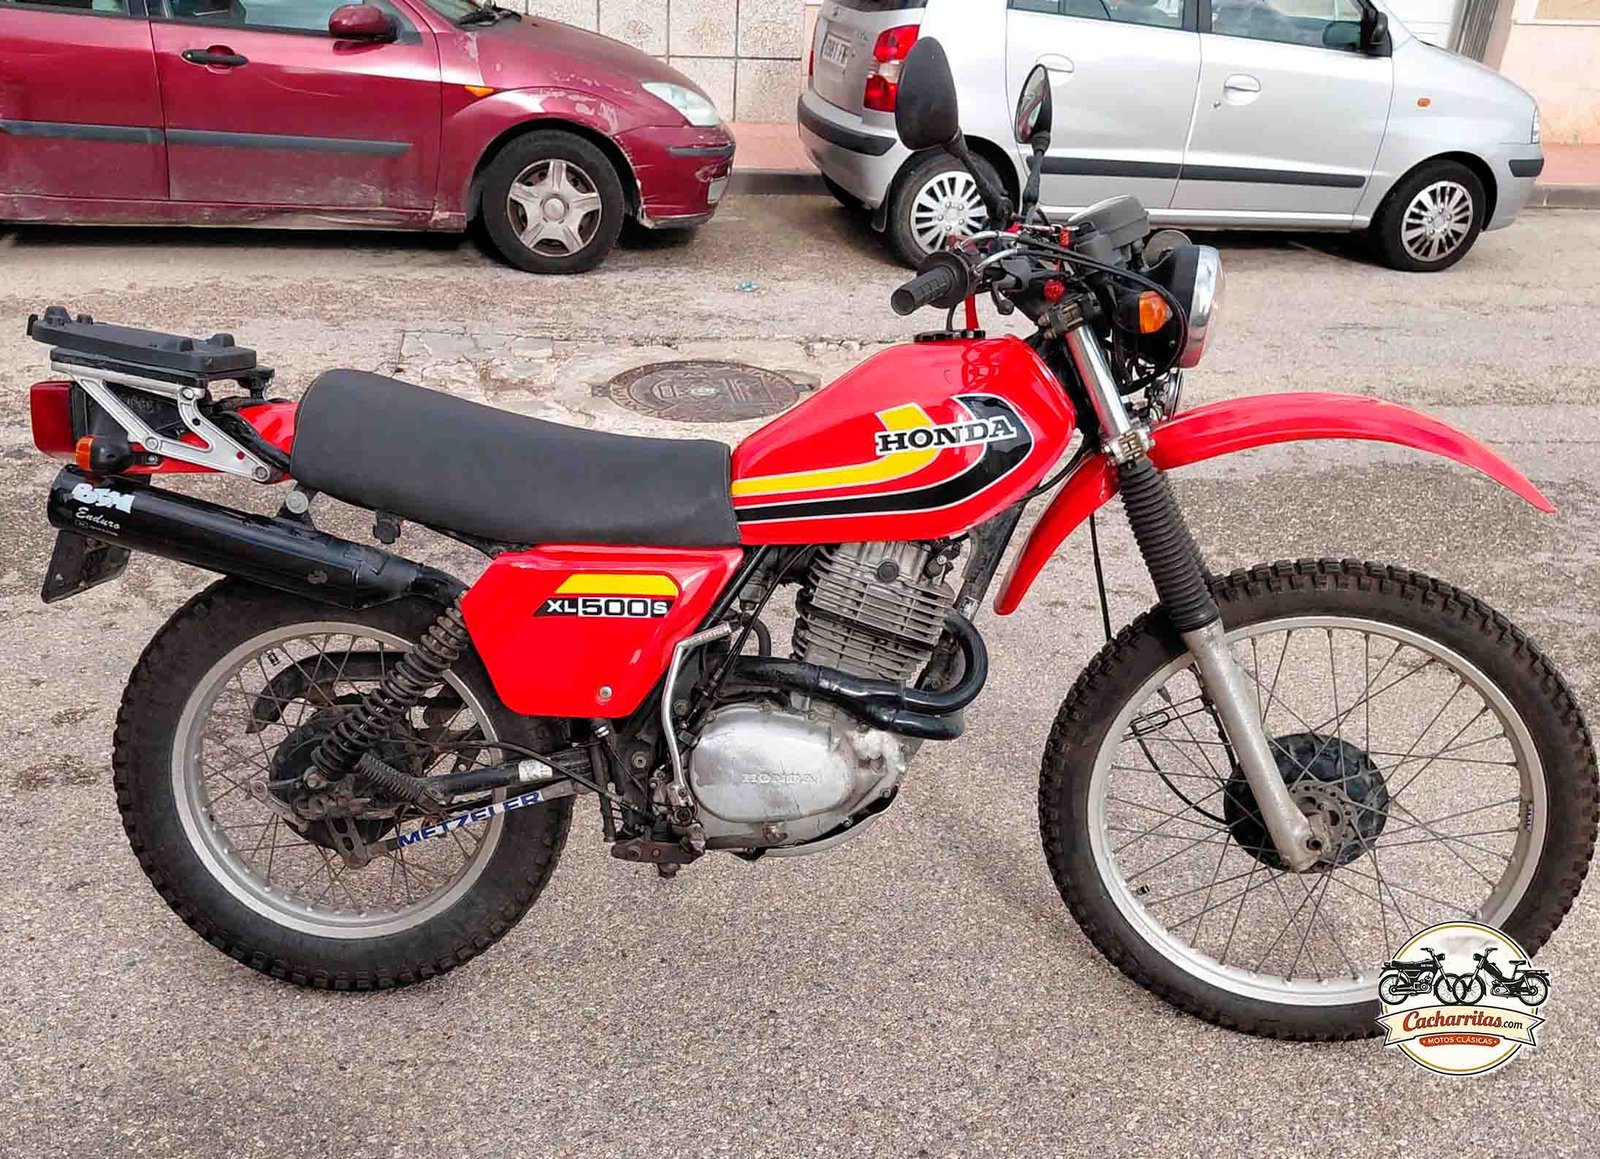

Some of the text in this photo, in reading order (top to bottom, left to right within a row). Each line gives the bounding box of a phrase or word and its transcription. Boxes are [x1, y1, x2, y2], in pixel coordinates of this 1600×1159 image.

[878, 418, 1015, 452] HONDA
[75, 506, 121, 530] Enduro
[741, 771, 818, 785] HONDA
